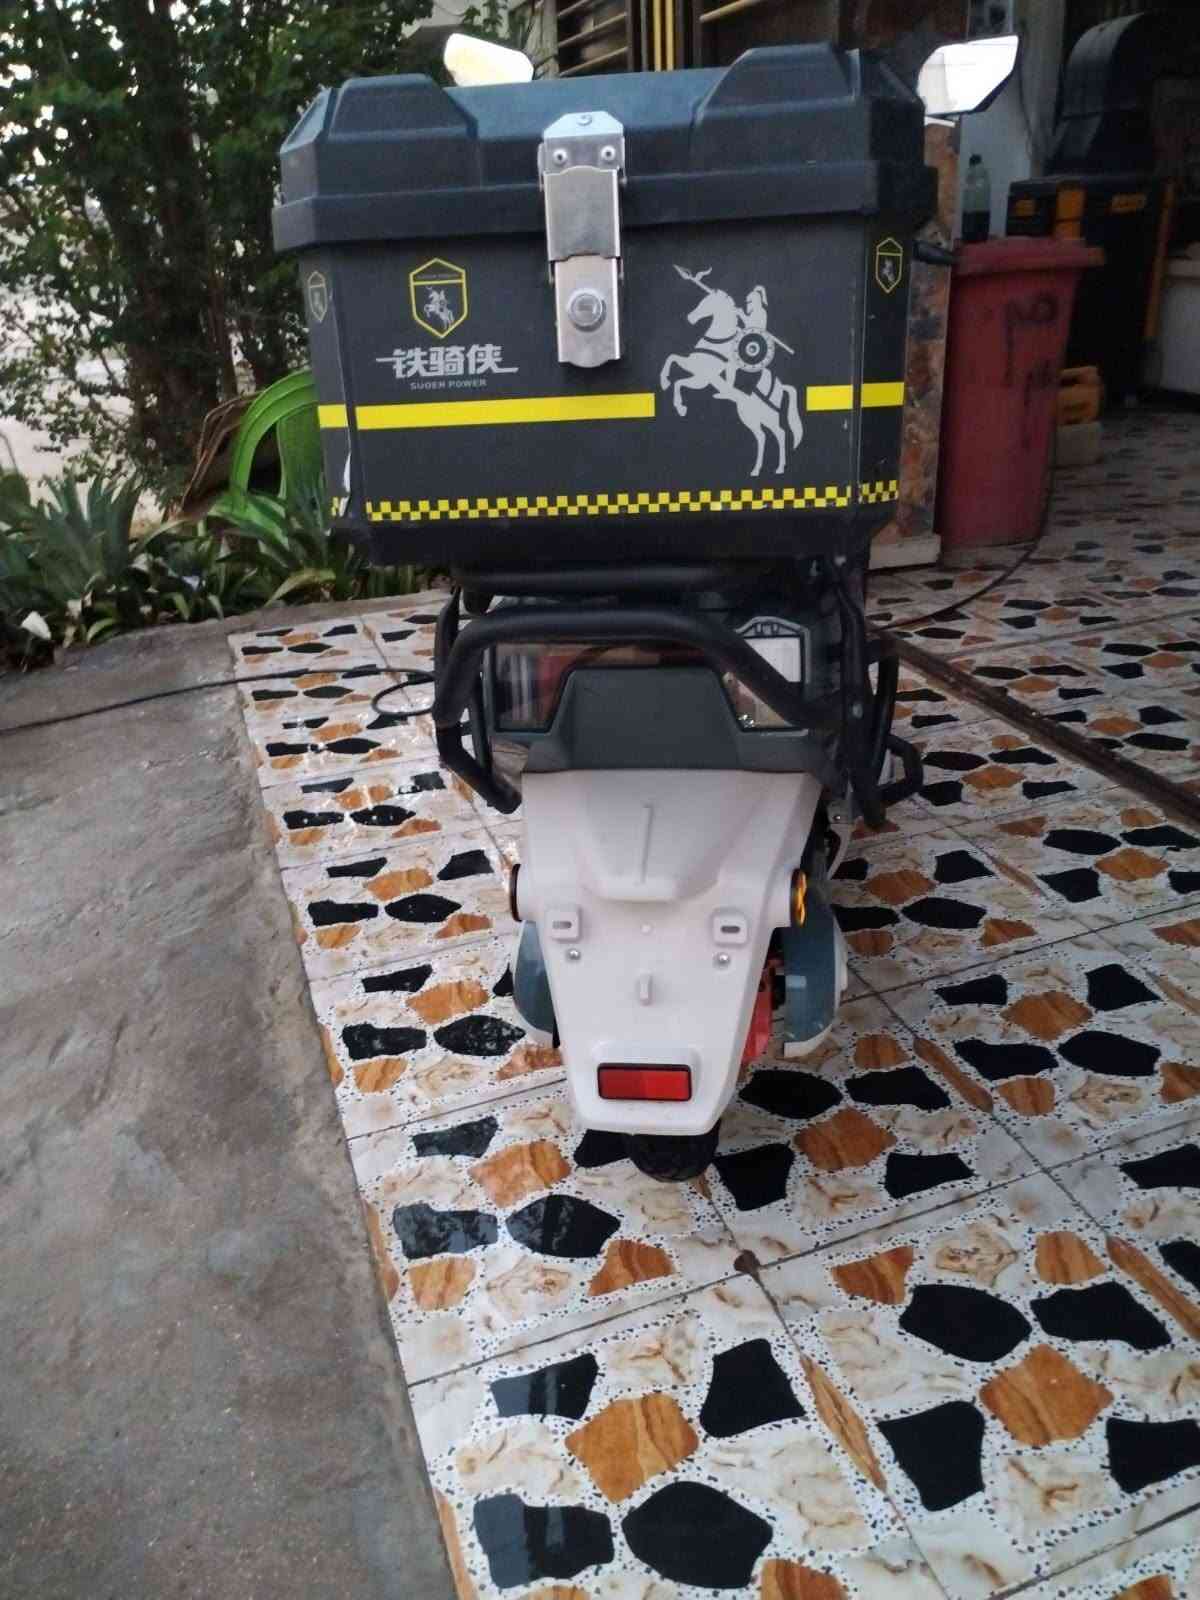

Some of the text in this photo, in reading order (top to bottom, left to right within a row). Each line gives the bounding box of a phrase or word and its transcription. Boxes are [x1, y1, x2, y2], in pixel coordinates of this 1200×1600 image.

[376, 344, 519, 379] 铁骑侠
[449, 379, 488, 389] POWER
